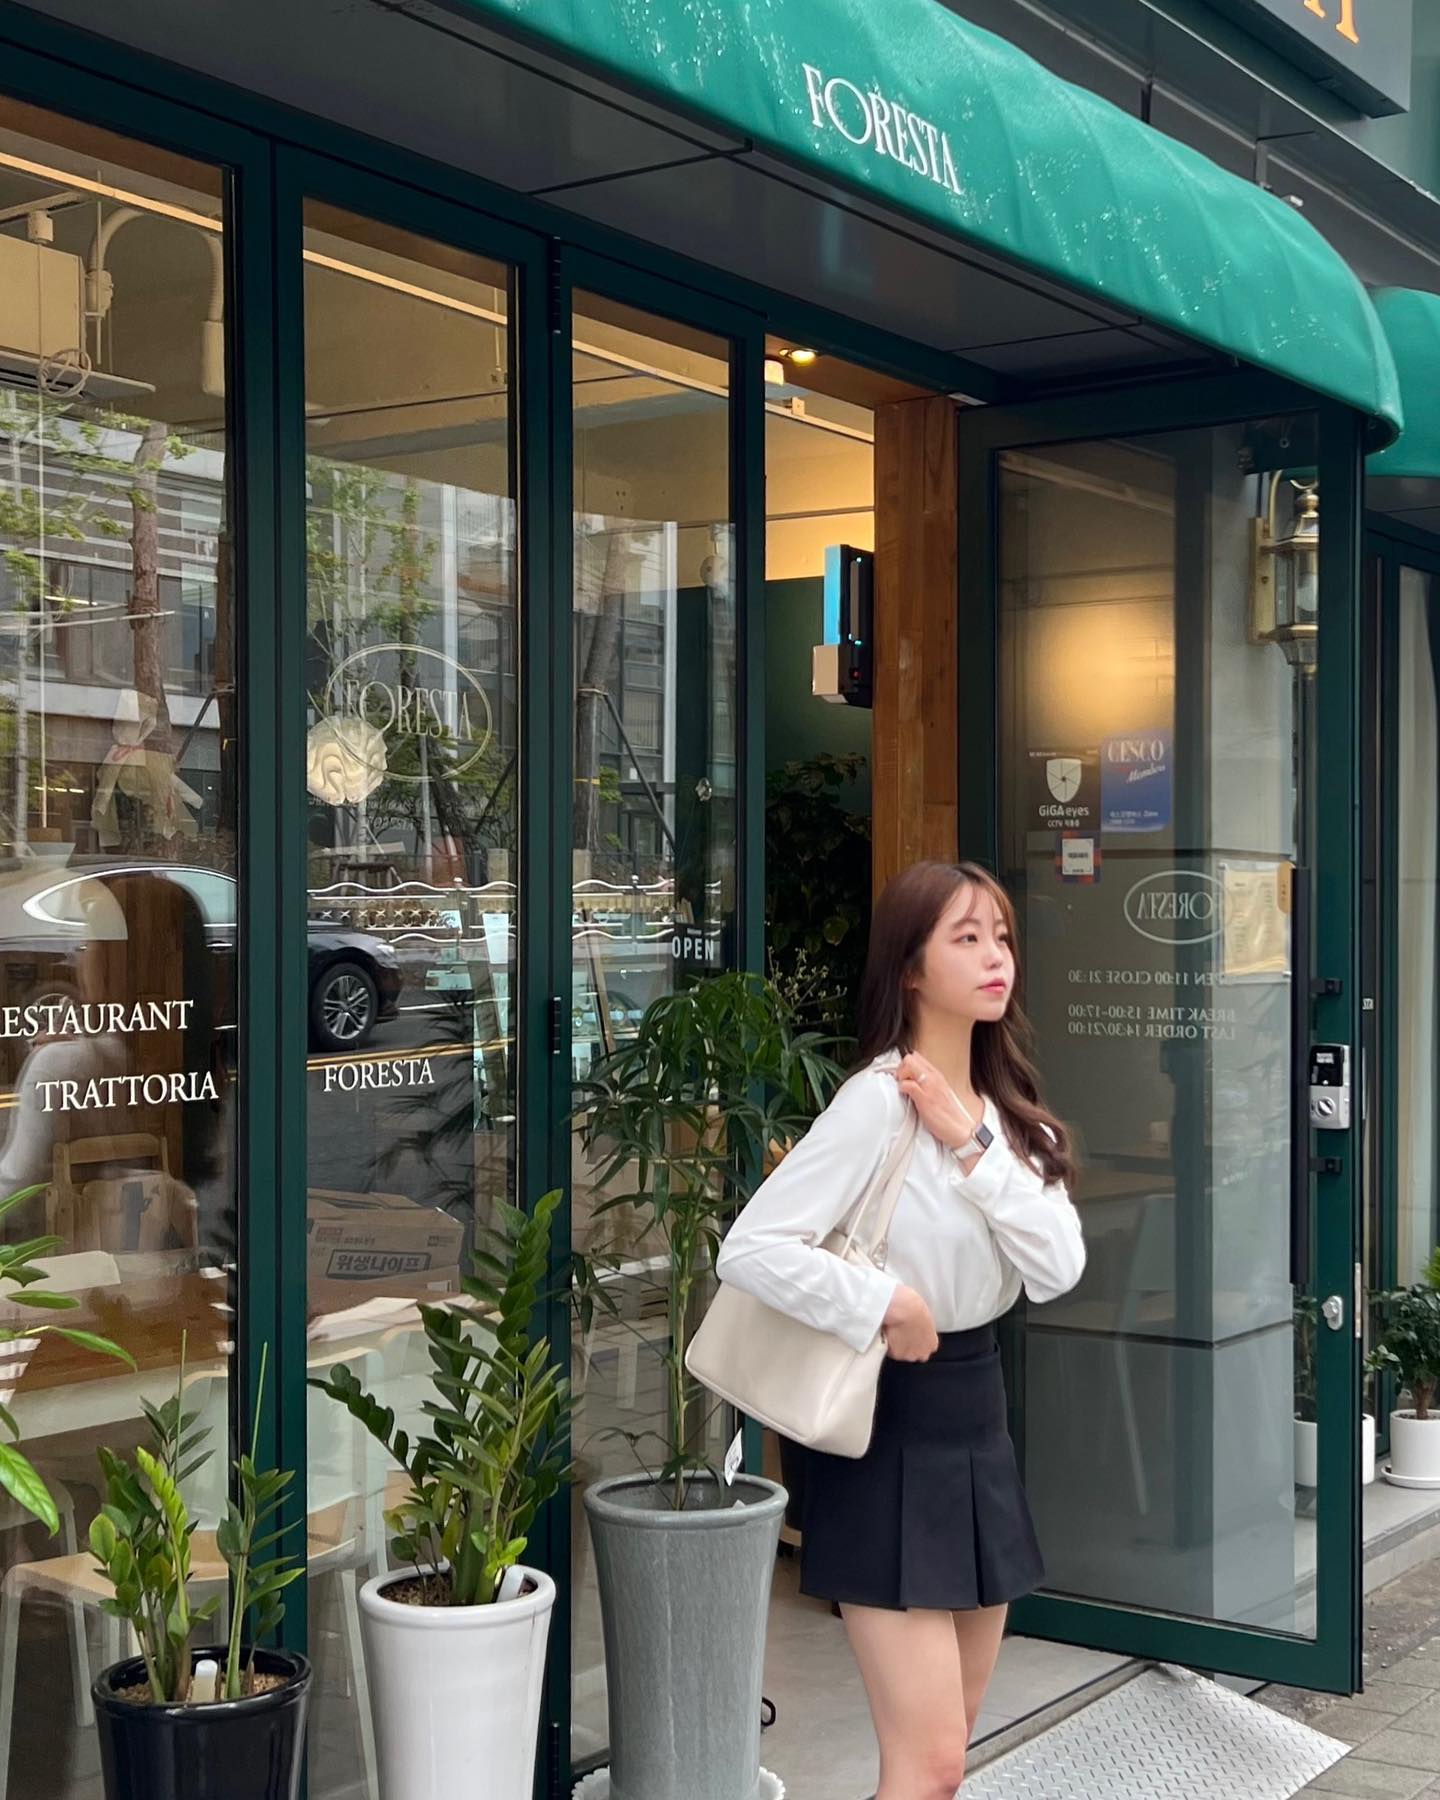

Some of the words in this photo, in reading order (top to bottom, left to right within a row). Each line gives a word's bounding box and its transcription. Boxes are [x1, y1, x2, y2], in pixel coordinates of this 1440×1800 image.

[802, 62, 965, 195] FORESTA
[346, 679, 473, 741] FORESTA
[671, 935, 714, 961] OPEN
[0, 999, 194, 1038] ESTAURANT
[35, 1071, 219, 1113] TRATTORIA
[323, 1058, 435, 1092] FORESTA
[336, 1254, 420, 1273] 위생나이프
